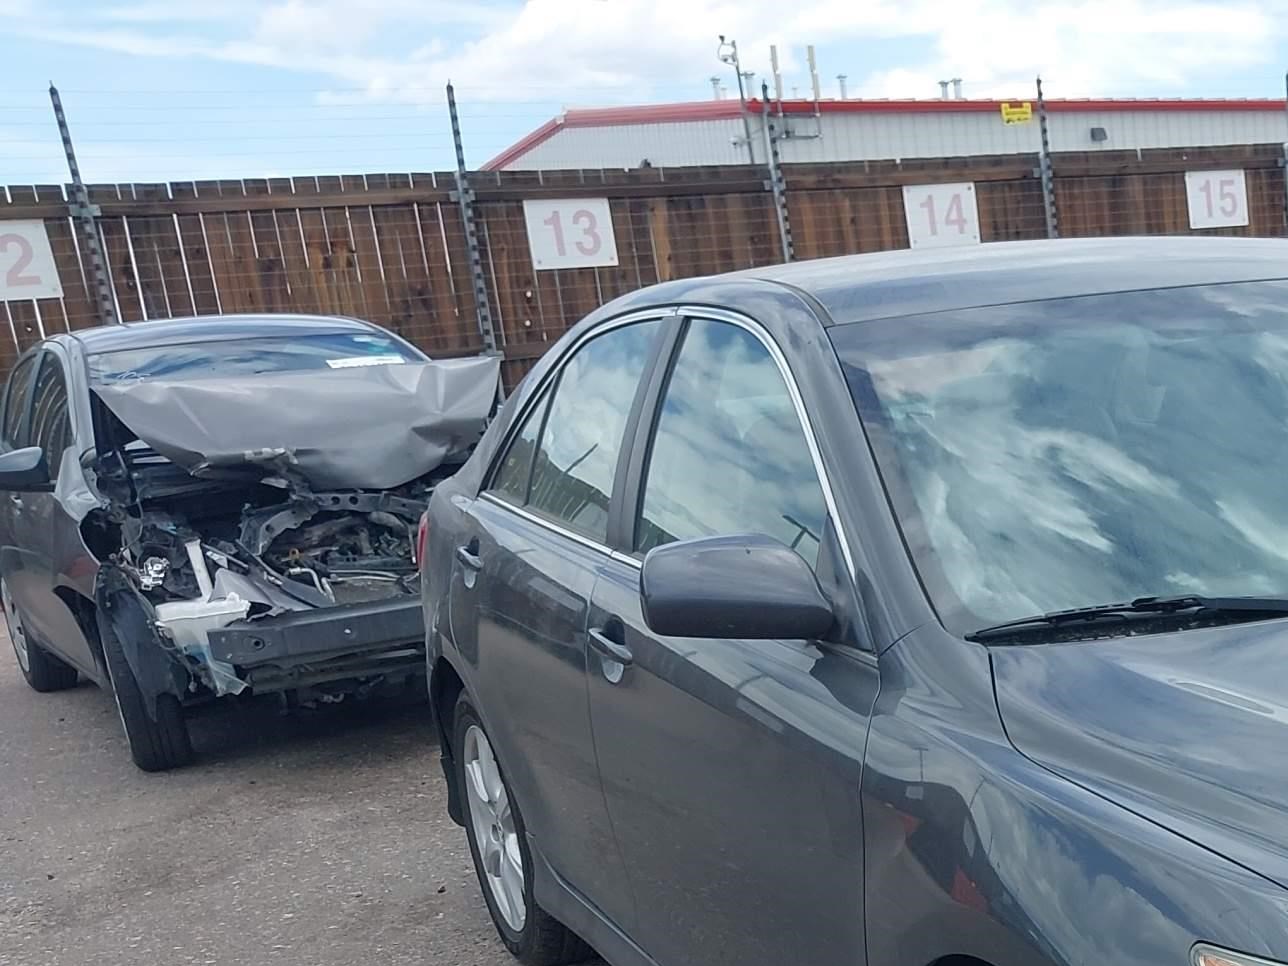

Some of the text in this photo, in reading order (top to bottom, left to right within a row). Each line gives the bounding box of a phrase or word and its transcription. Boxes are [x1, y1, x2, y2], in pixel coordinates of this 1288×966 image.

[919, 193, 968, 236] 14
[1199, 179, 1238, 218] 15
[543, 209, 602, 257] 13
